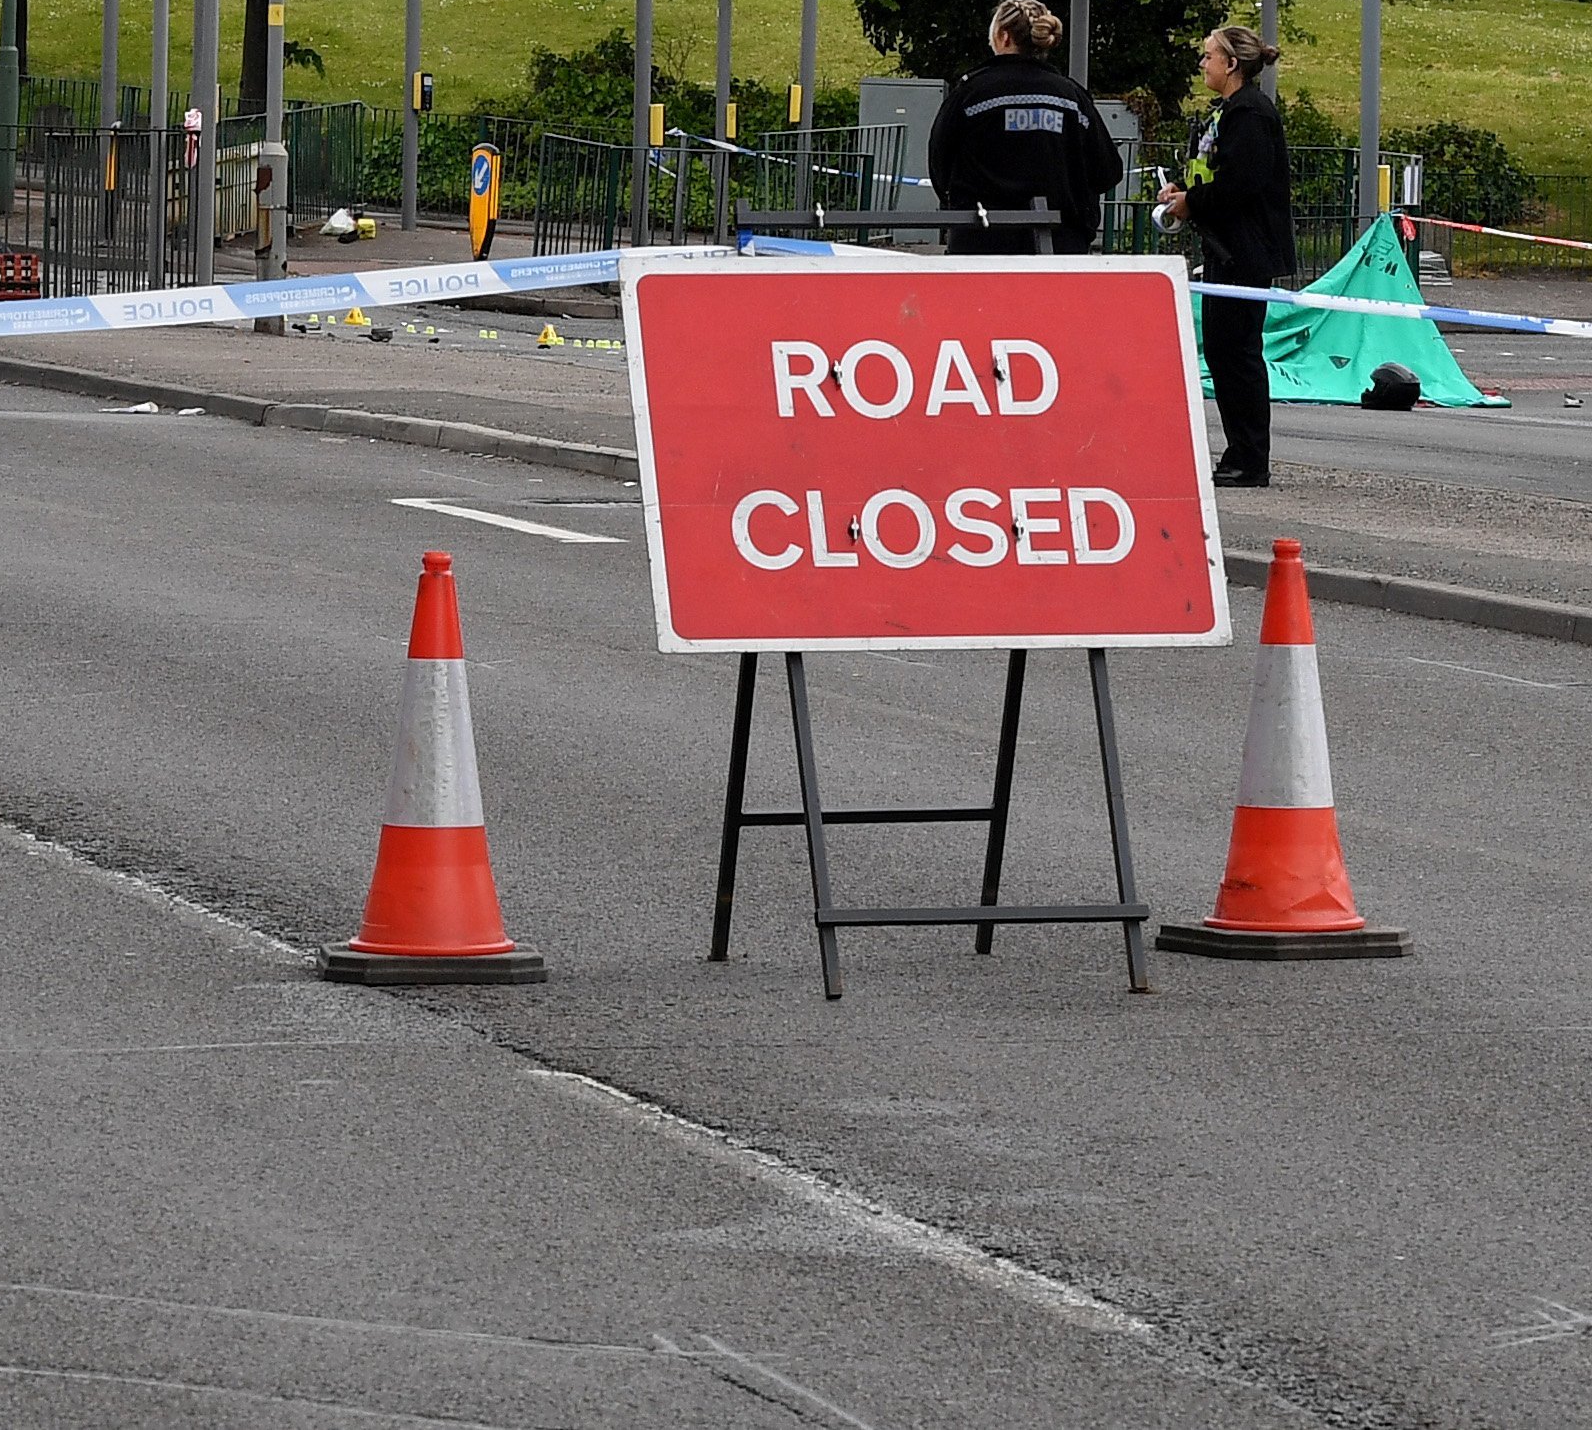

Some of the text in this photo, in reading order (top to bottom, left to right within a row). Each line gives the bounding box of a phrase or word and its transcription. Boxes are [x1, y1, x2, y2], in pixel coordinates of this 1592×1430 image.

[1006, 109, 1063, 133] POLICE
[771, 338, 1059, 419] ROAD
[731, 487, 1136, 570] CLOSED
